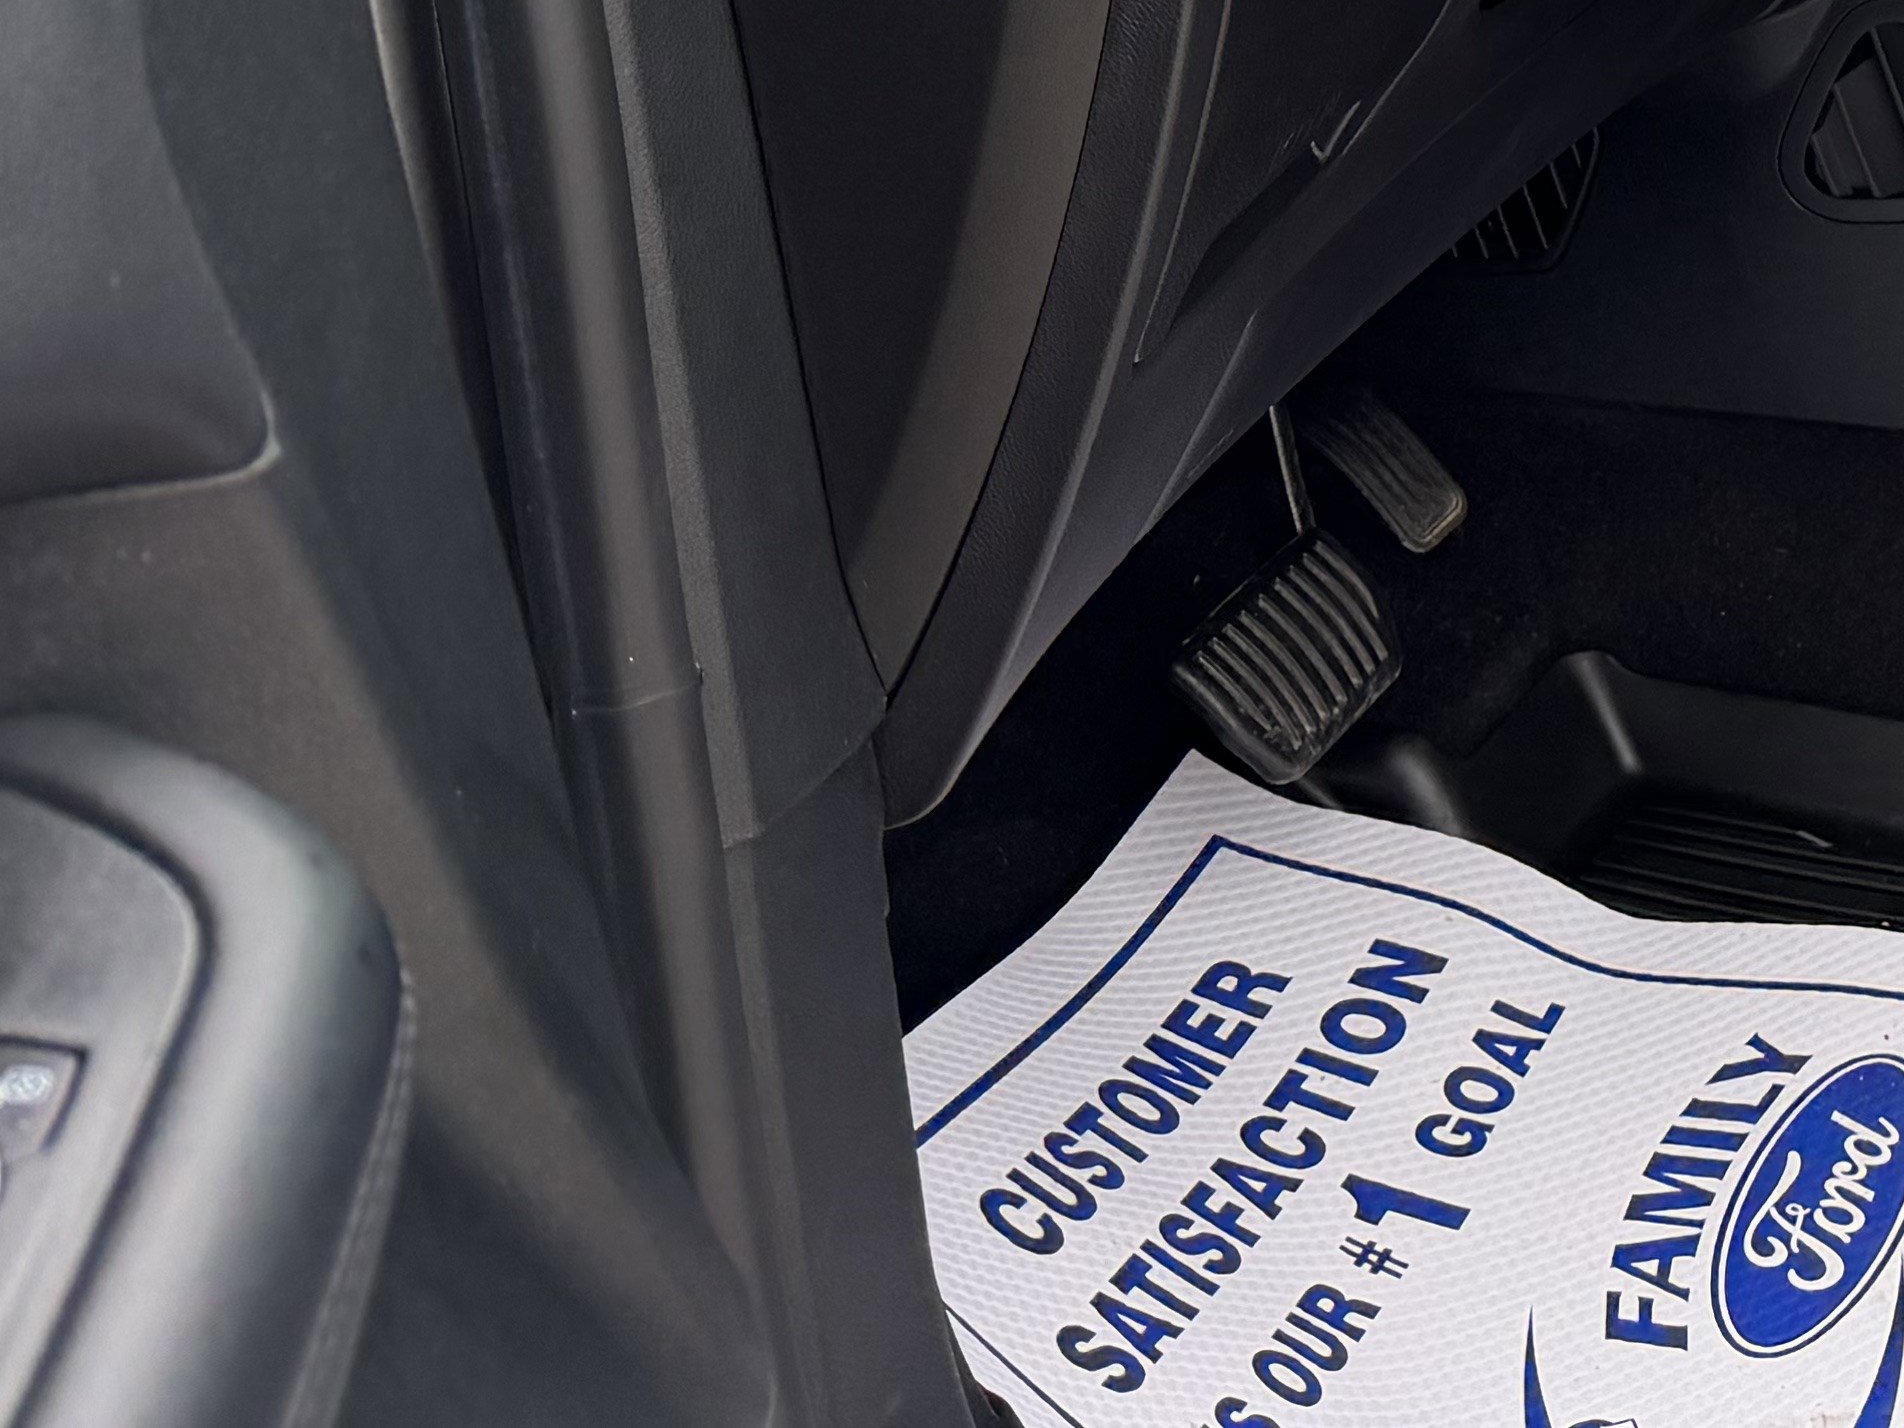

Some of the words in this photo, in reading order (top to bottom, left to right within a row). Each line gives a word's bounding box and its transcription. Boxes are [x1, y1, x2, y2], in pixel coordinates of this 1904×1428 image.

[978, 959, 1293, 1256] CUSTOMER
[1055, 938, 1450, 1393] SATISFACTION
[1251, 1282, 1382, 1407] OUR
[1414, 999, 1567, 1158] GOAL
[1604, 1031, 1813, 1352] FAMILY
[1741, 1109, 1900, 1294] Ford
